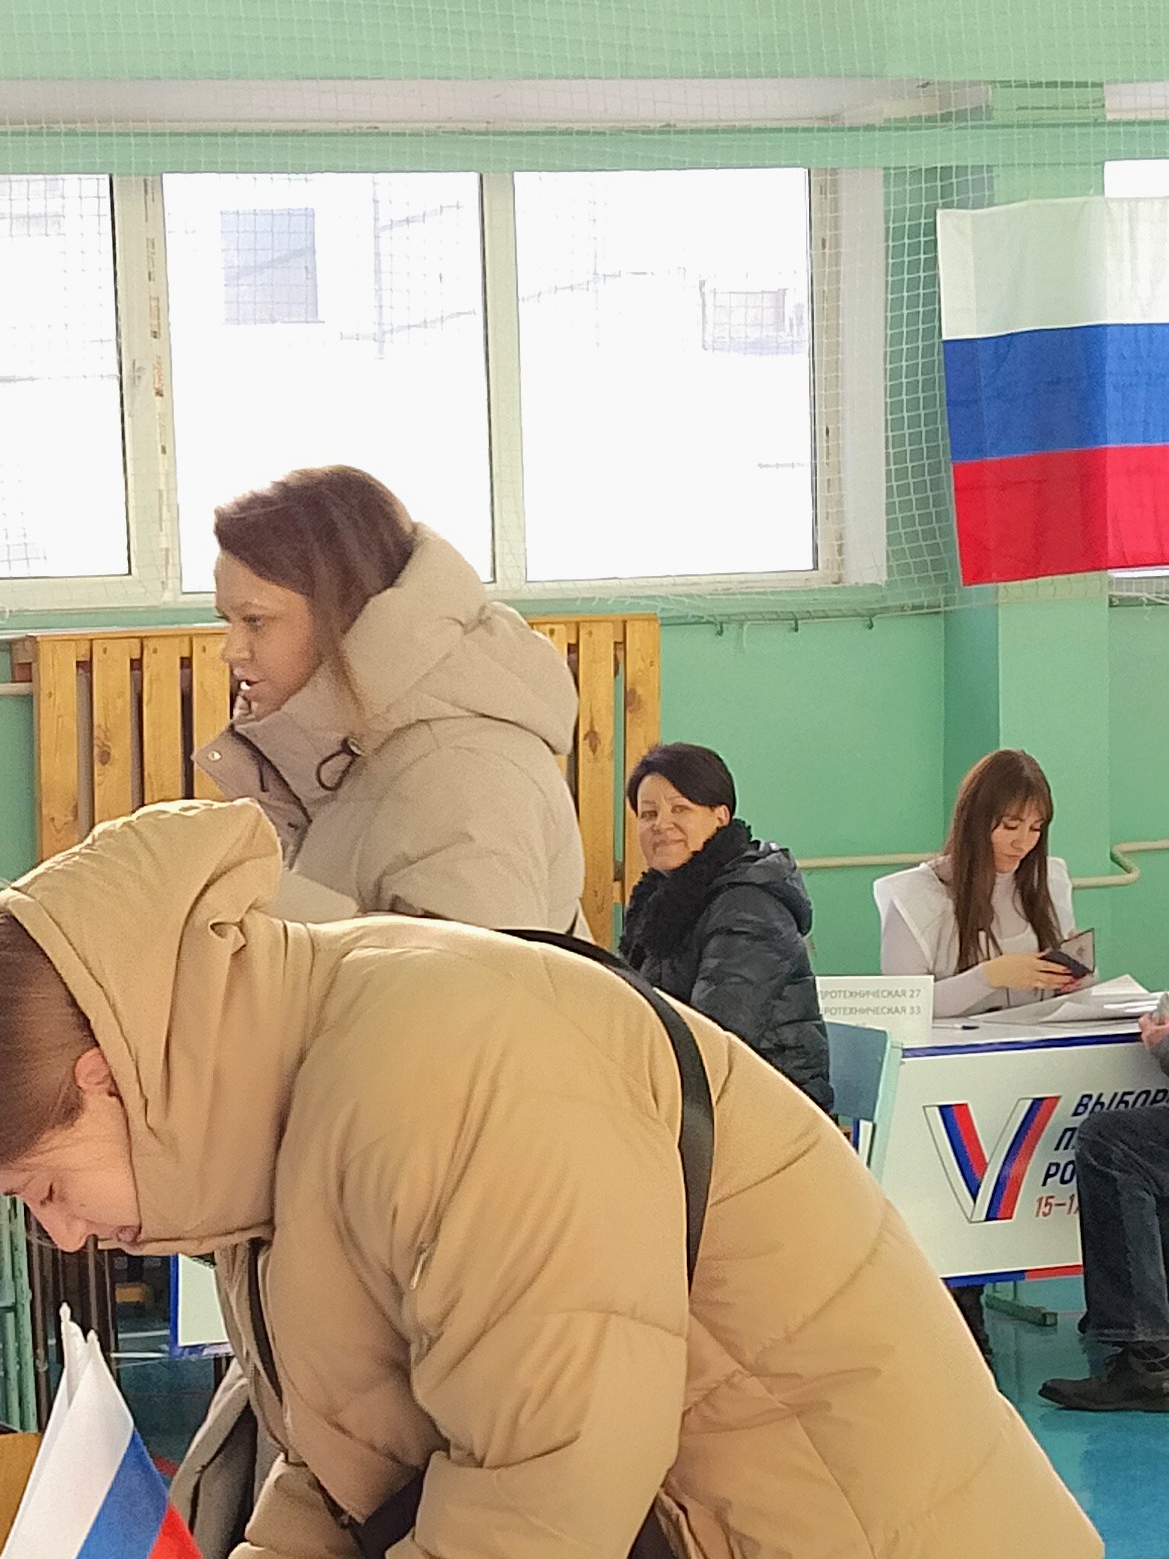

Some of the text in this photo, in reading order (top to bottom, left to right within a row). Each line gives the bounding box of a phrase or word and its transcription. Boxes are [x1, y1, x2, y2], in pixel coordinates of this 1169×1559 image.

[909, 988, 922, 999] 27
[822, 1005, 907, 1016] РОТЕХНИЧЕСКАЯ
[1071, 1088, 1169, 1118] ВЫБОР
